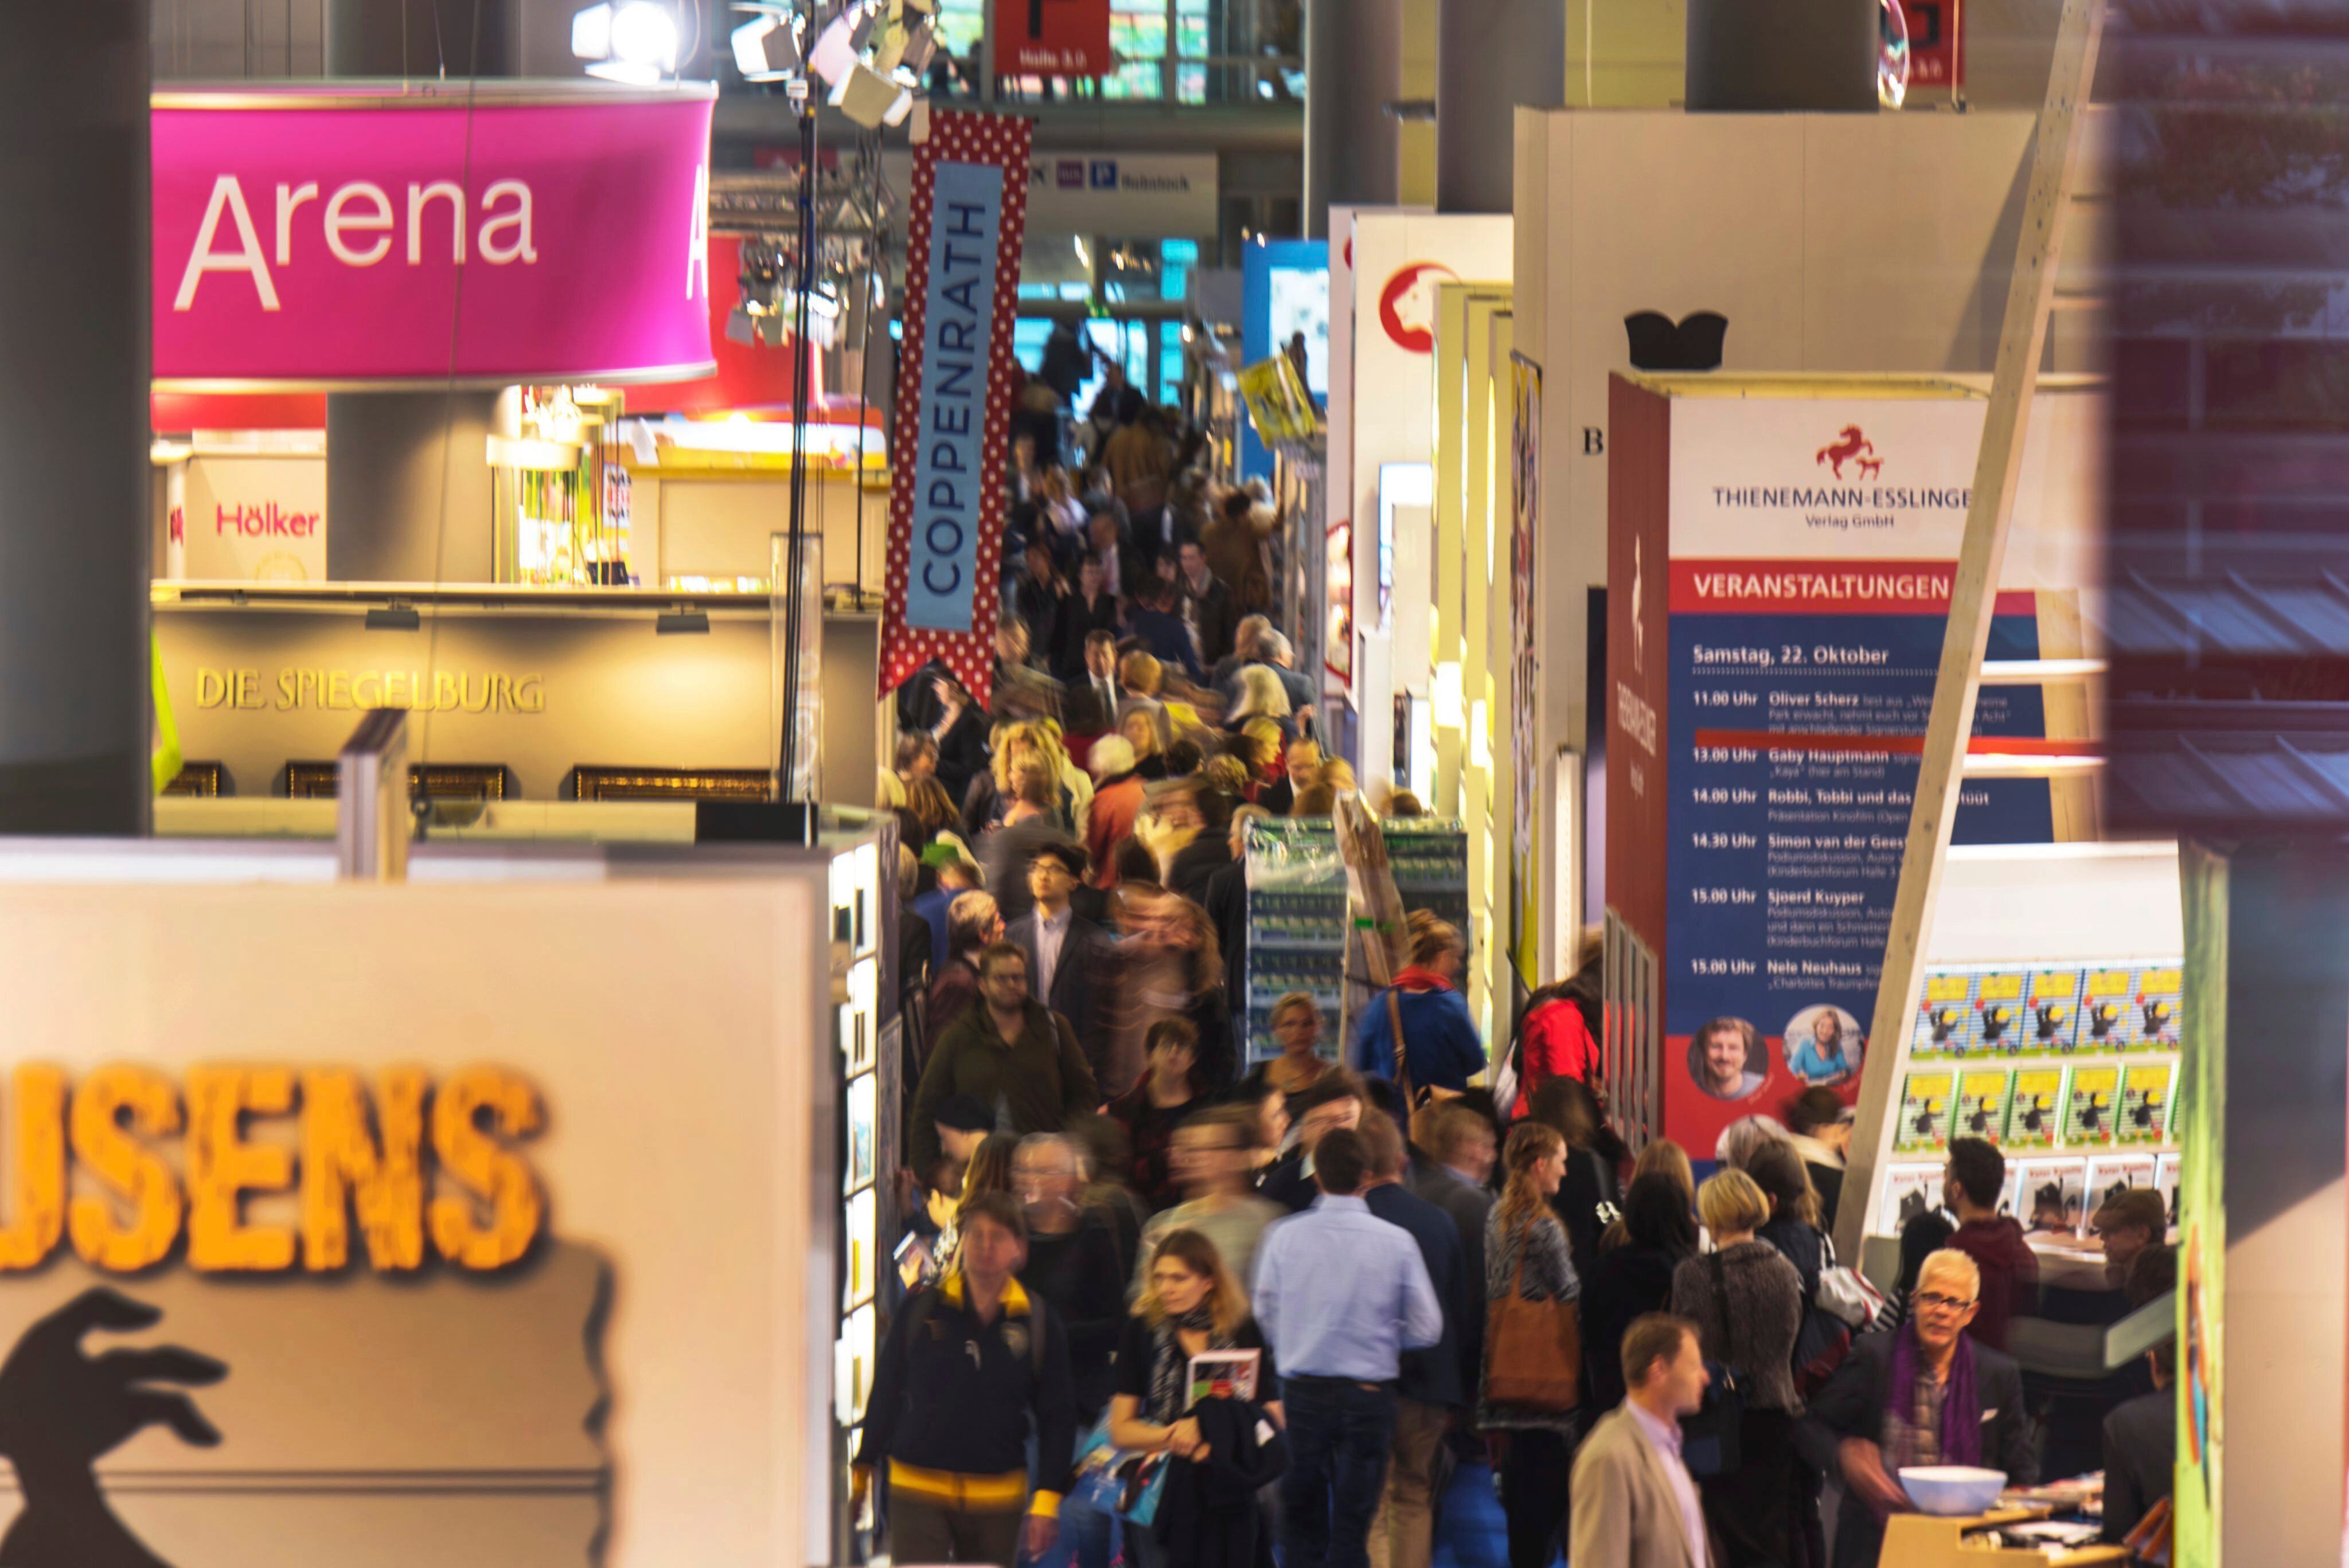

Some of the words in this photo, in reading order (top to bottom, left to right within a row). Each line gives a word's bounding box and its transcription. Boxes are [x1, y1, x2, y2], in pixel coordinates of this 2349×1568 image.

[174, 175, 537, 311] Arena
[922, 201, 985, 596] COPPENRATH
[216, 501, 319, 537] Hölker
[1805, 514, 1848, 530] Verlag
[1852, 514, 1894, 528] GmbH
[1694, 573, 1949, 600] VERANSTALTUNGEN
[1693, 644, 1775, 667] Samstag,
[1781, 646, 1808, 664] 22.
[1813, 645, 1888, 665] Oktober
[196, 667, 266, 710] DIE
[275, 668, 547, 714] SPIEGELBURG
[1693, 691, 1729, 706] 11.00
[1733, 691, 1758, 706] Uhr
[1769, 691, 1811, 706] Oliver
[1815, 691, 1859, 707] Scherz
[1693, 747, 1729, 763] 13.00
[1733, 747, 1758, 763] Uhr
[1768, 748, 1804, 765] Gaby
[1808, 748, 1889, 765] Hauptmann
[1693, 788, 1729, 804] 14.00
[1733, 788, 1758, 804] Uhr
[1768, 788, 1812, 805] Robbi,
[1816, 789, 1854, 804] Tobbi
[1857, 789, 1884, 804] und
[1887, 789, 1911, 804] das
[1692, 832, 1728, 848] 14.30
[1732, 832, 1758, 848] Uhr
[1767, 832, 1811, 849] Simon
[1814, 836, 1841, 849] van
[1844, 834, 1867, 849] der
[1692, 888, 1728, 904] 15.00
[1731, 888, 1758, 904] Uhr
[1767, 889, 1811, 906] Sjoerd
[1815, 890, 1865, 906] Kuyper
[1691, 959, 1728, 974] 15.00
[1731, 959, 1757, 974] Uhr
[1767, 959, 1798, 975] Nele
[1801, 959, 1862, 975] Neuhaus
